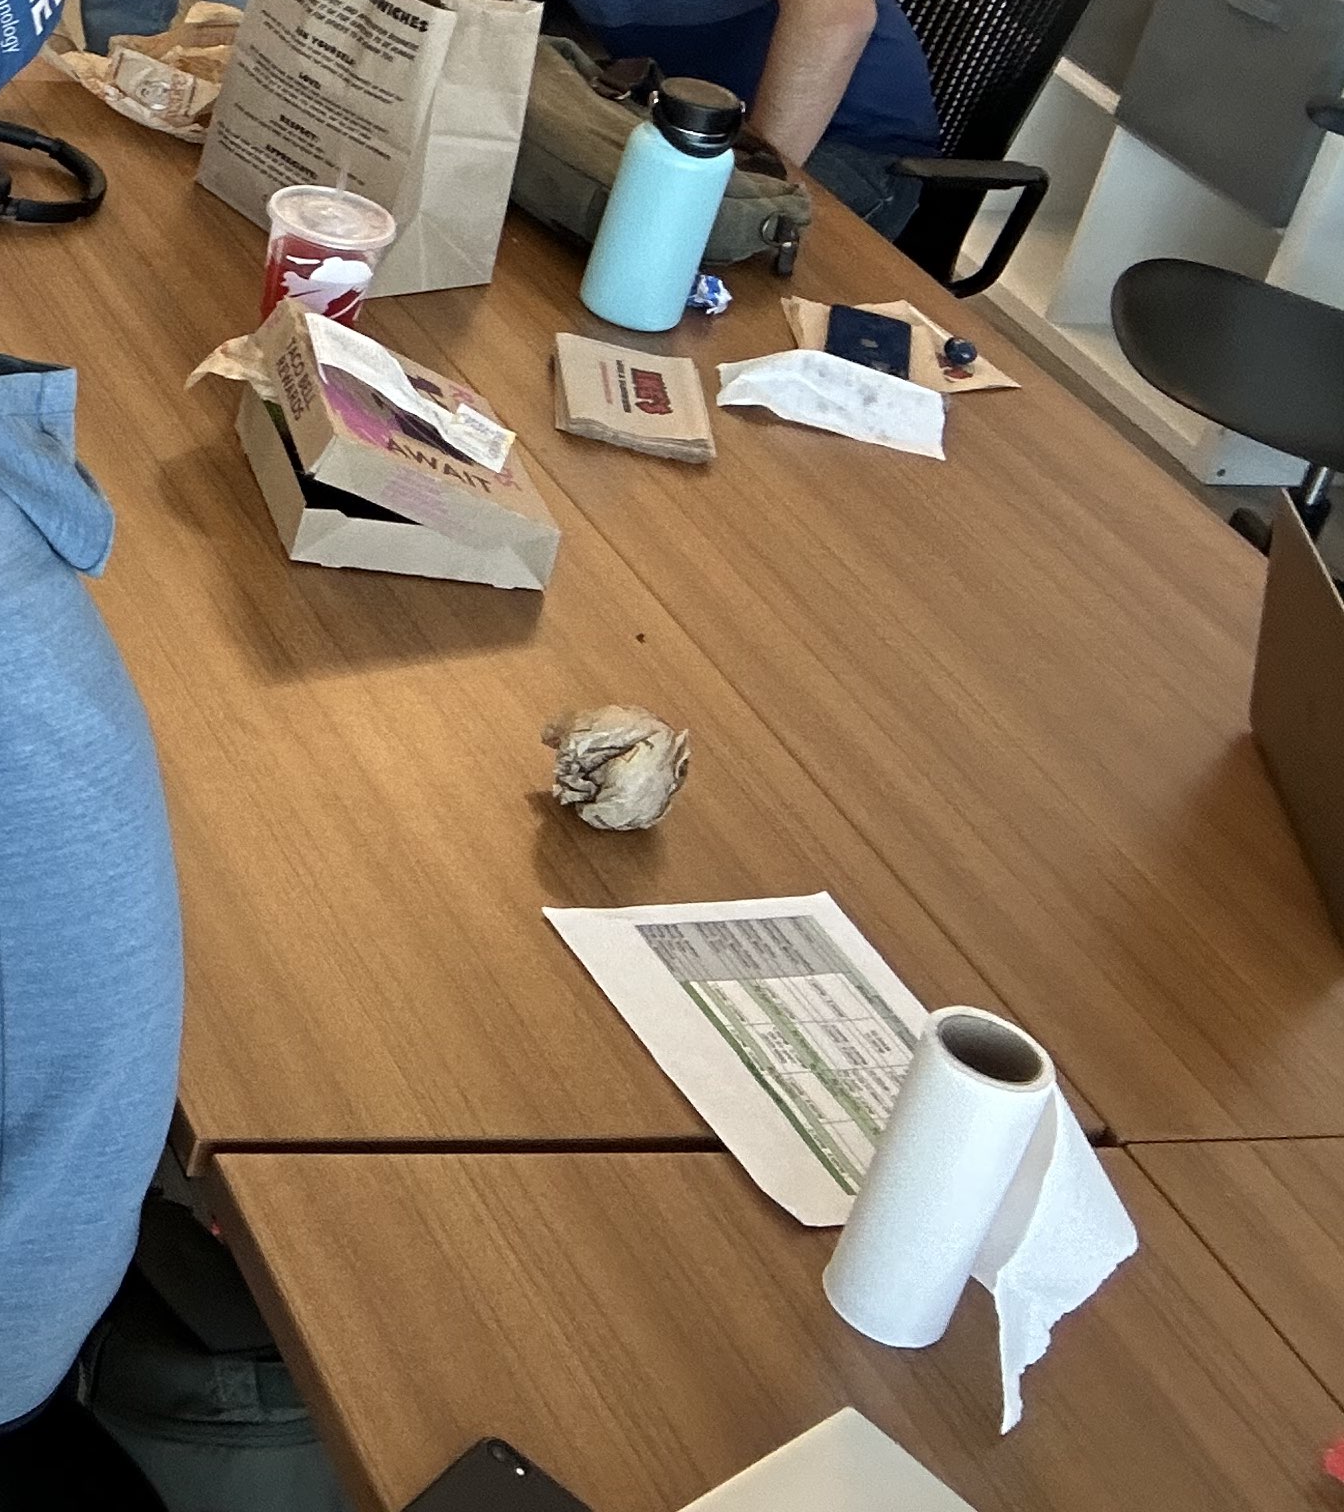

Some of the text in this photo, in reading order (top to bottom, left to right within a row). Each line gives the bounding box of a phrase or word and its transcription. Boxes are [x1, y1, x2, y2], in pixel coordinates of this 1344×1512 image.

[286, 335, 306, 377] TACO
[275, 354, 304, 421] REWARDS
[386, 437, 492, 494] AWAIT
